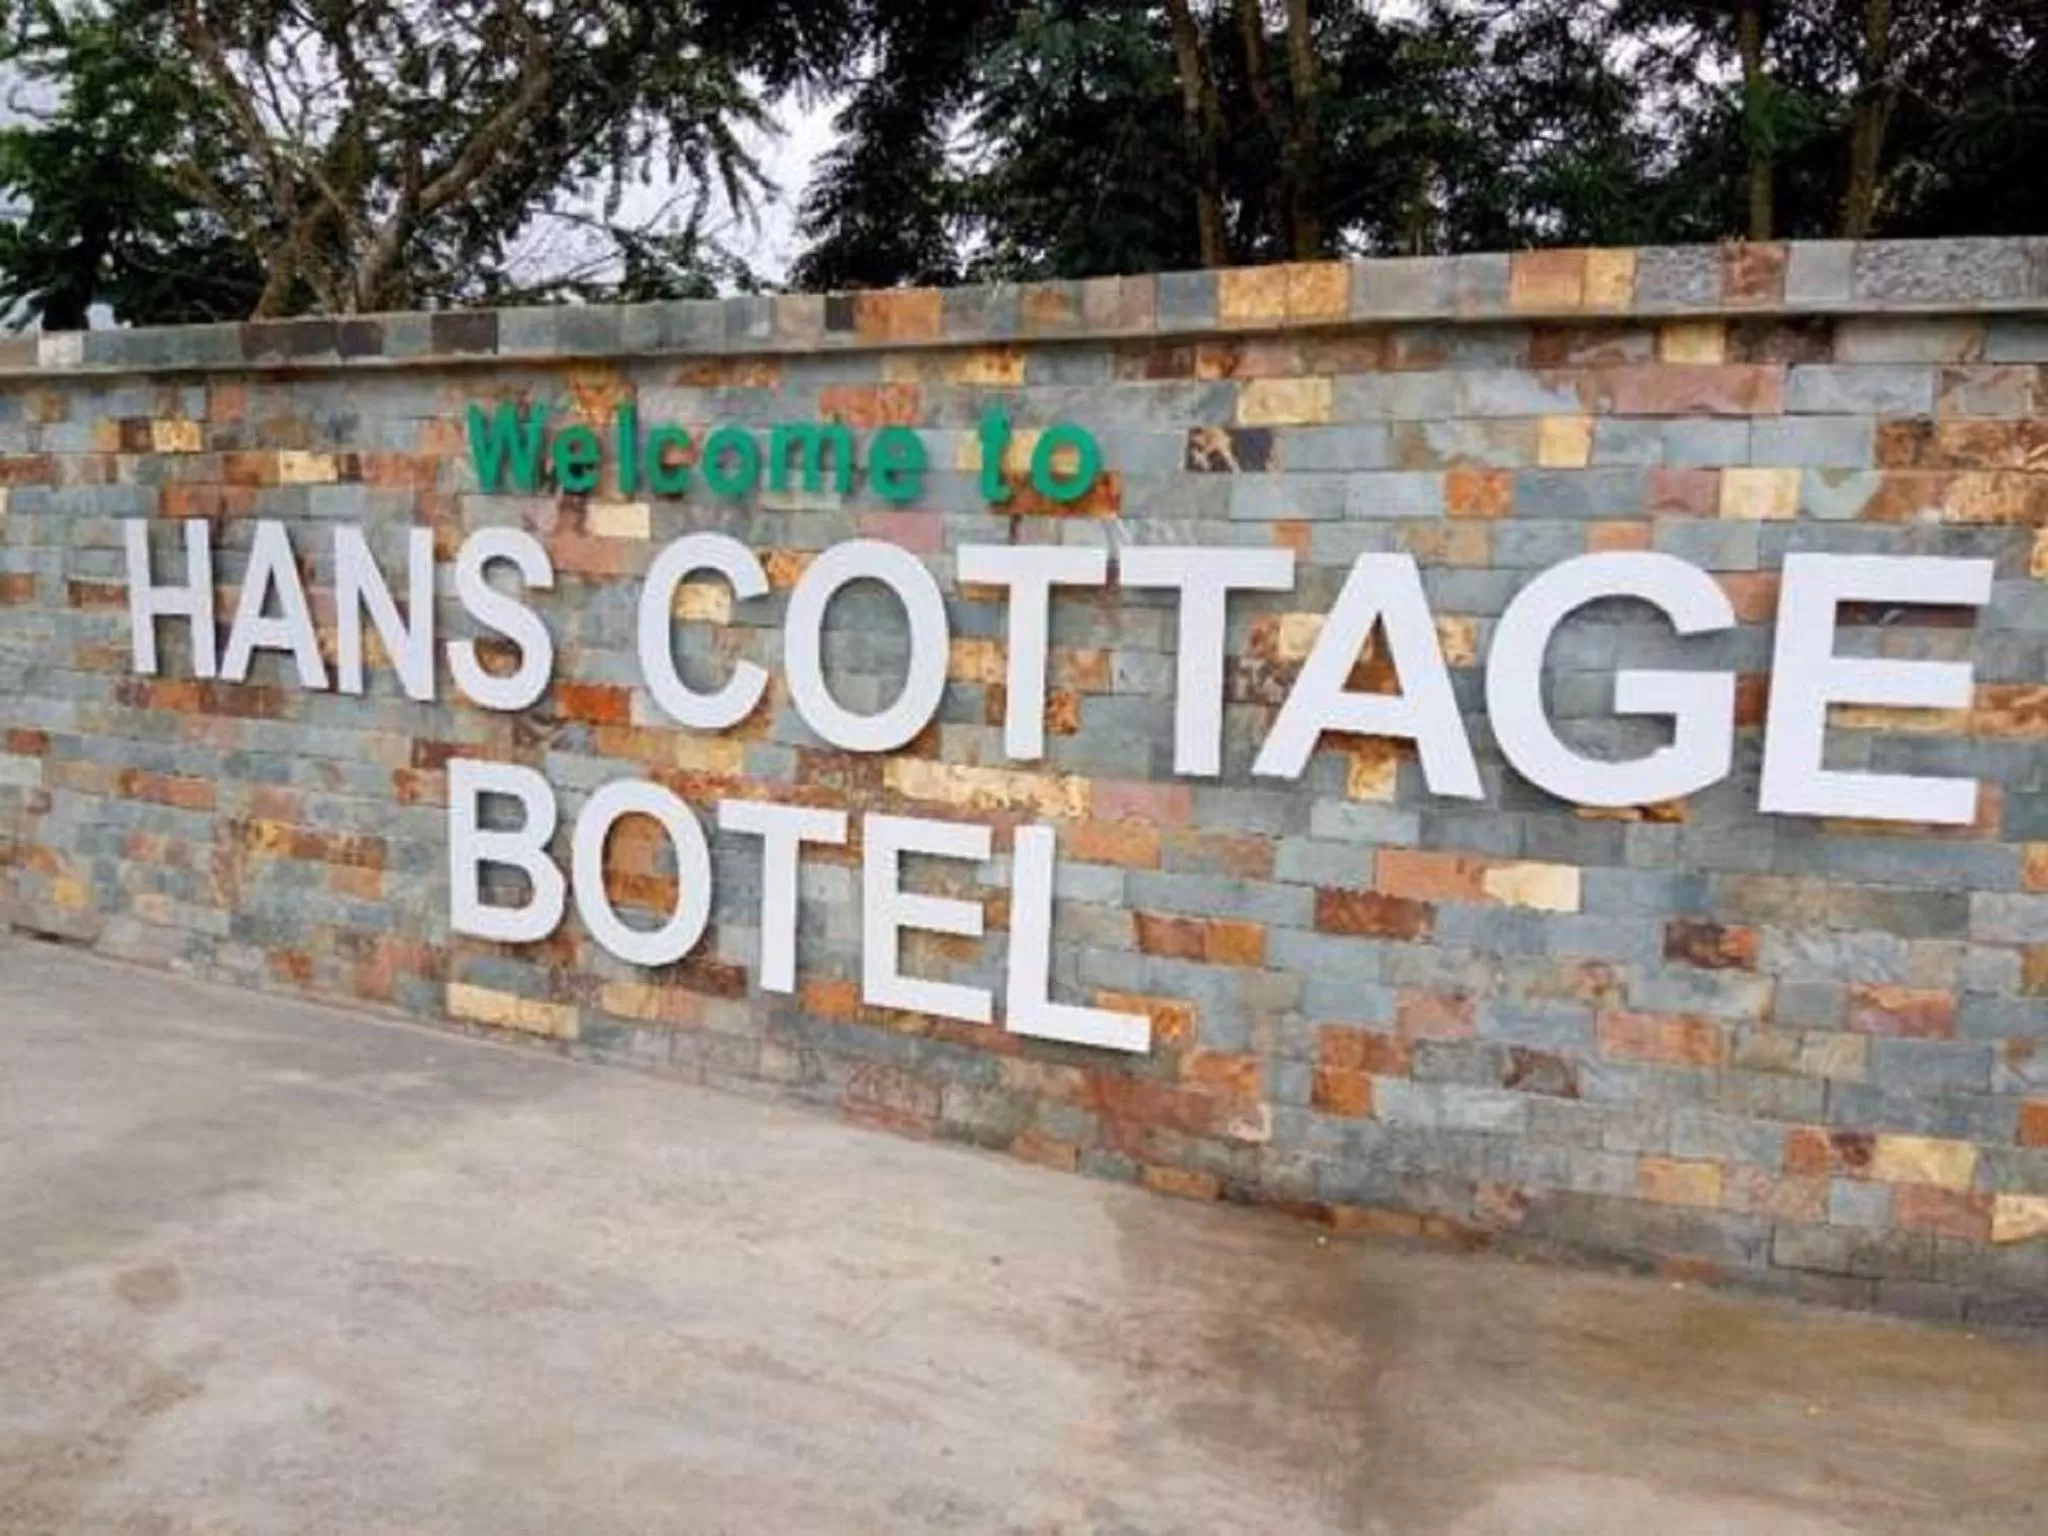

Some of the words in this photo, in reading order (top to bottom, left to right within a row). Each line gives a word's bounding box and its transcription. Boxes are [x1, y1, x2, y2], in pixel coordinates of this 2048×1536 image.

[466, 402, 926, 502] Welcome
[977, 404, 1105, 505] to
[123, 517, 555, 711] HANS
[637, 531, 1994, 825] COTTAGE
[447, 759, 1151, 1052] BOTEL
